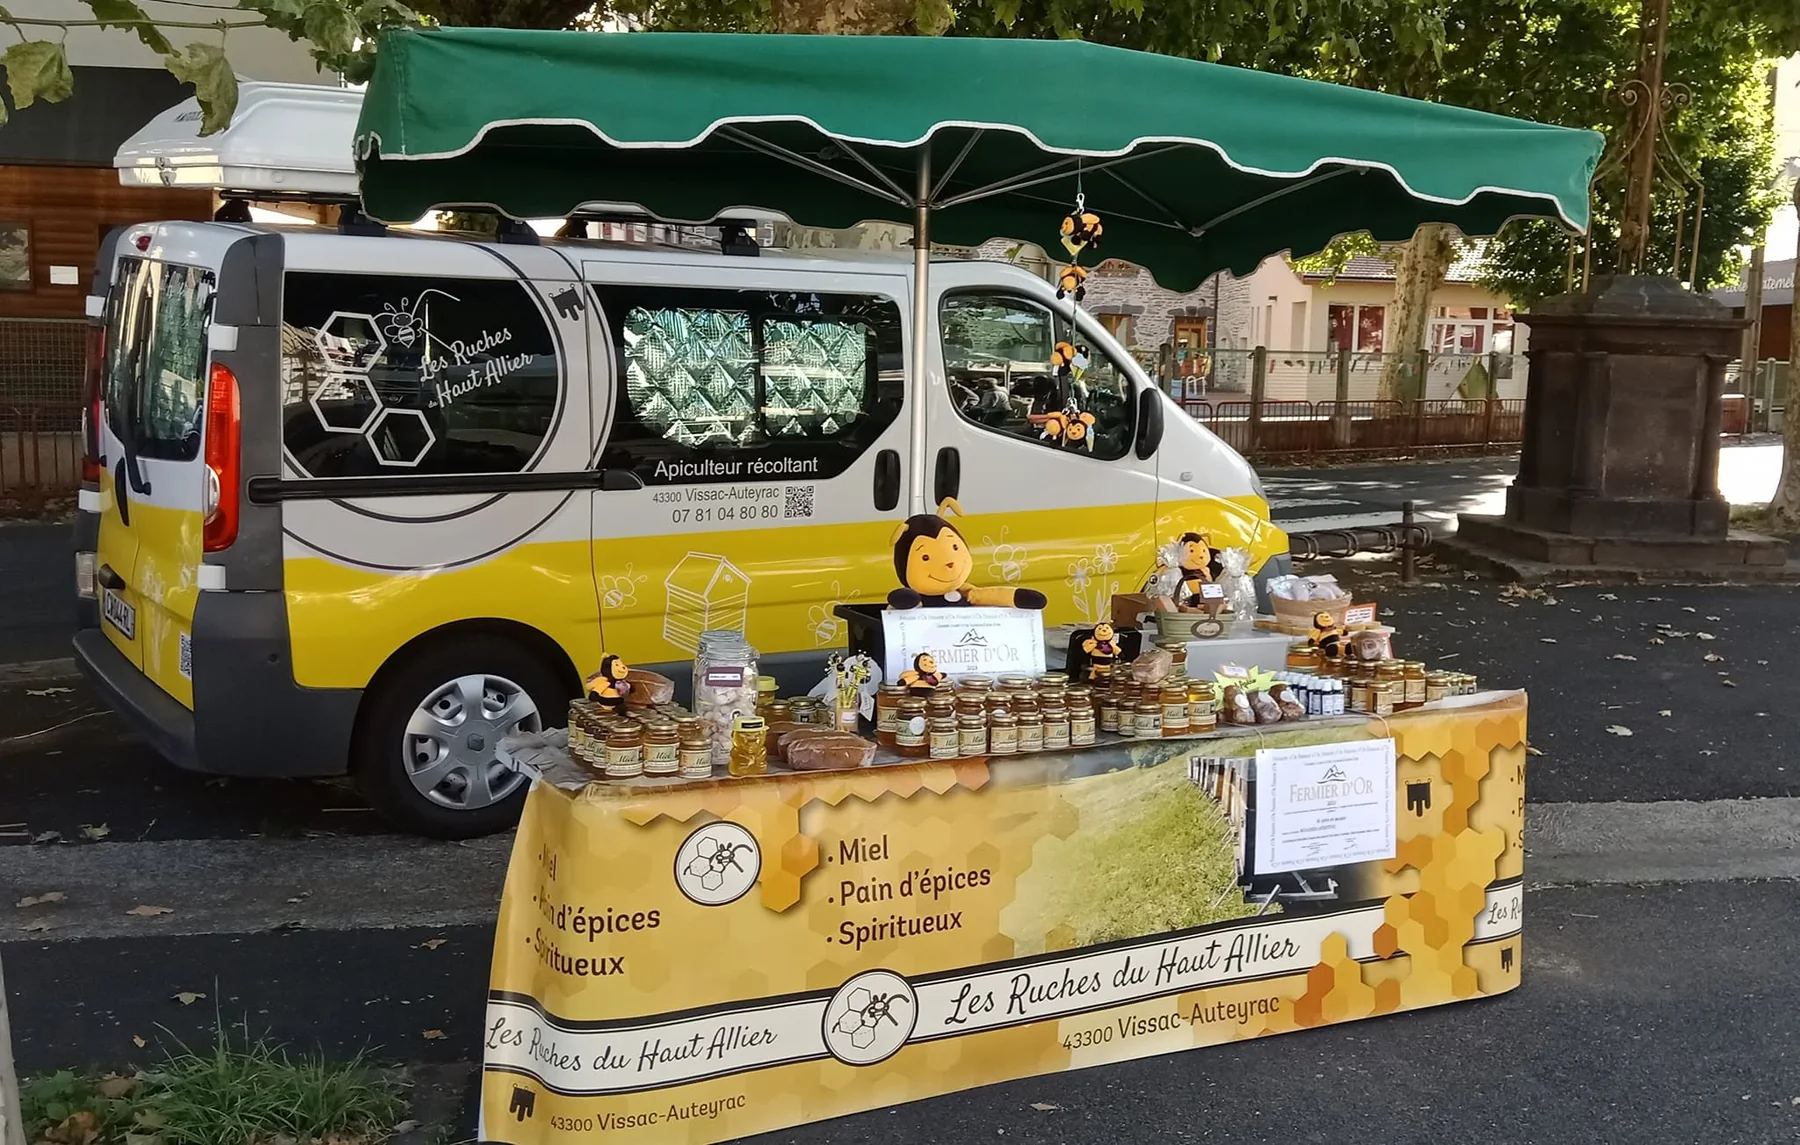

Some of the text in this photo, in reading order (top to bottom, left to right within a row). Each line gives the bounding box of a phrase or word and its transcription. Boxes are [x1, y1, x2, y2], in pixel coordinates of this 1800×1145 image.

[418, 328, 512, 382] Les Ruches
[436, 369, 482, 408] Haut
[485, 353, 533, 387] Allier
[654, 457, 819, 480] Apiculteur récoltant
[653, 486, 780, 503] 43300 Vissac-Auteyrac
[672, 504, 779, 523] 07 81 04 80 80
[839, 834, 889, 865] Miel
[840, 867, 991, 906] Pain d'épices
[556, 904, 661, 942] d'épices
[839, 911, 963, 950] Spiritueux
[1487, 902, 1508, 925] Les
[534, 927, 625, 976] Sritueux
[944, 933, 1301, 1026] Les Ruches du Haut Allier
[1062, 994, 1281, 1051] 43300 Vissac-Auteyrac
[486, 1017, 779, 1072] Les Ruches du Haut Allier
[550, 1094, 746, 1132] 43300 Vissac-Auteyrac
